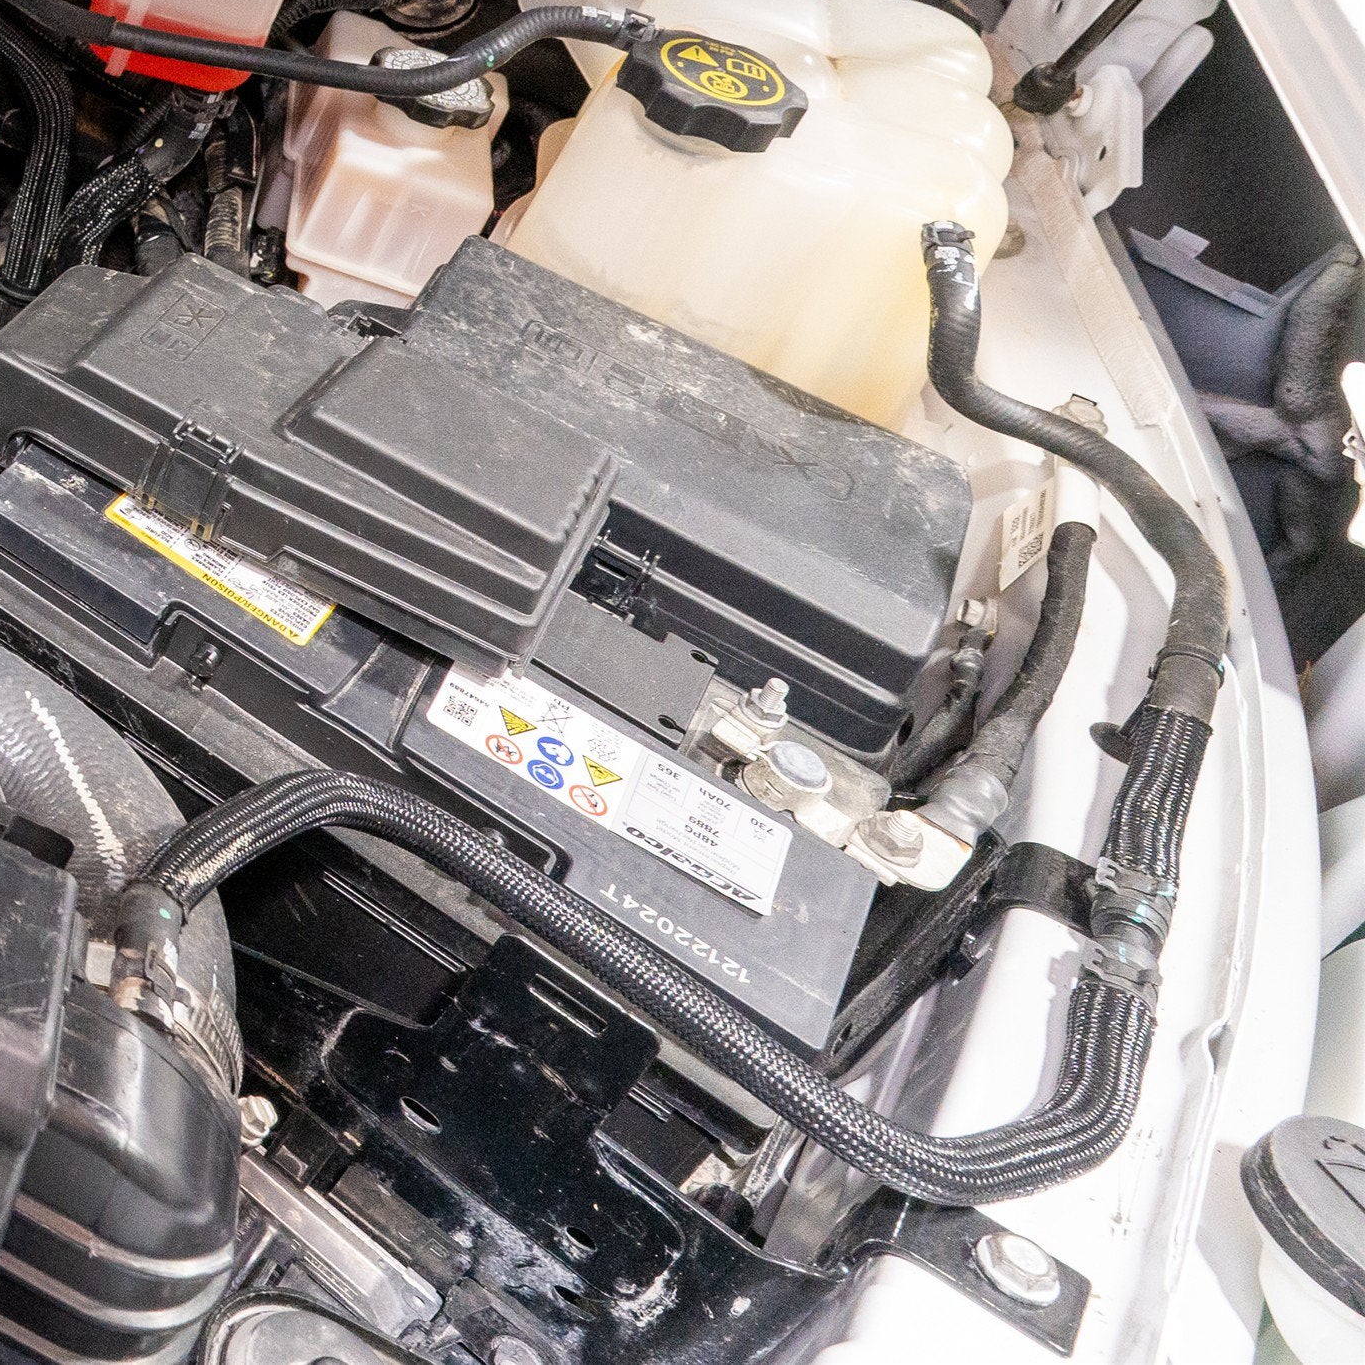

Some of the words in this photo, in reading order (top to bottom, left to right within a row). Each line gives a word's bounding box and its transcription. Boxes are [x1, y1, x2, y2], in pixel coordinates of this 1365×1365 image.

[201, 571, 287, 633] DANGER/POISON
[656, 762, 681, 781] 365
[697, 785, 730, 810] 70Ah
[687, 813, 720, 836] 7889
[749, 815, 774, 835] 730
[599, 882, 752, 985] 12122024T
